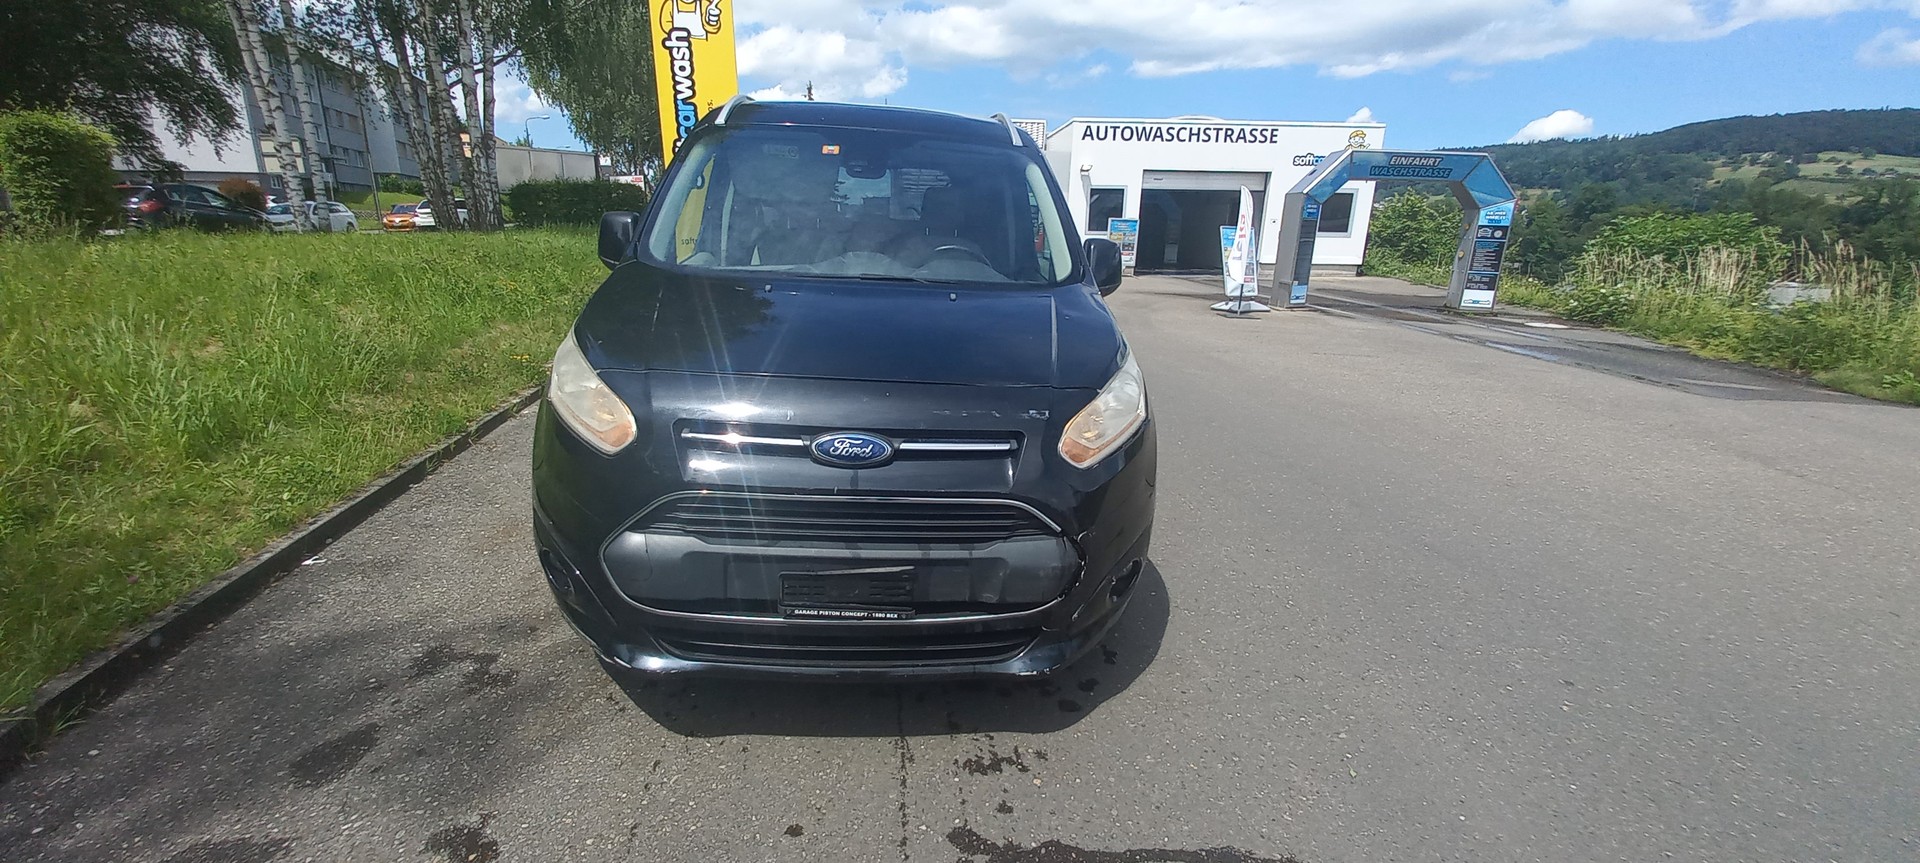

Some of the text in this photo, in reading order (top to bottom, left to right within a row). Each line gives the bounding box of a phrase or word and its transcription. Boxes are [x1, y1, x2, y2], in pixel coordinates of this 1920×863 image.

[1081, 125, 1279, 144] AUTOWASCHSTRASSE
[1389, 156, 1442, 167] EINFAHRT
[1371, 166, 1452, 177] WASCHSTRASSE
[829, 438, 874, 458] Ford
